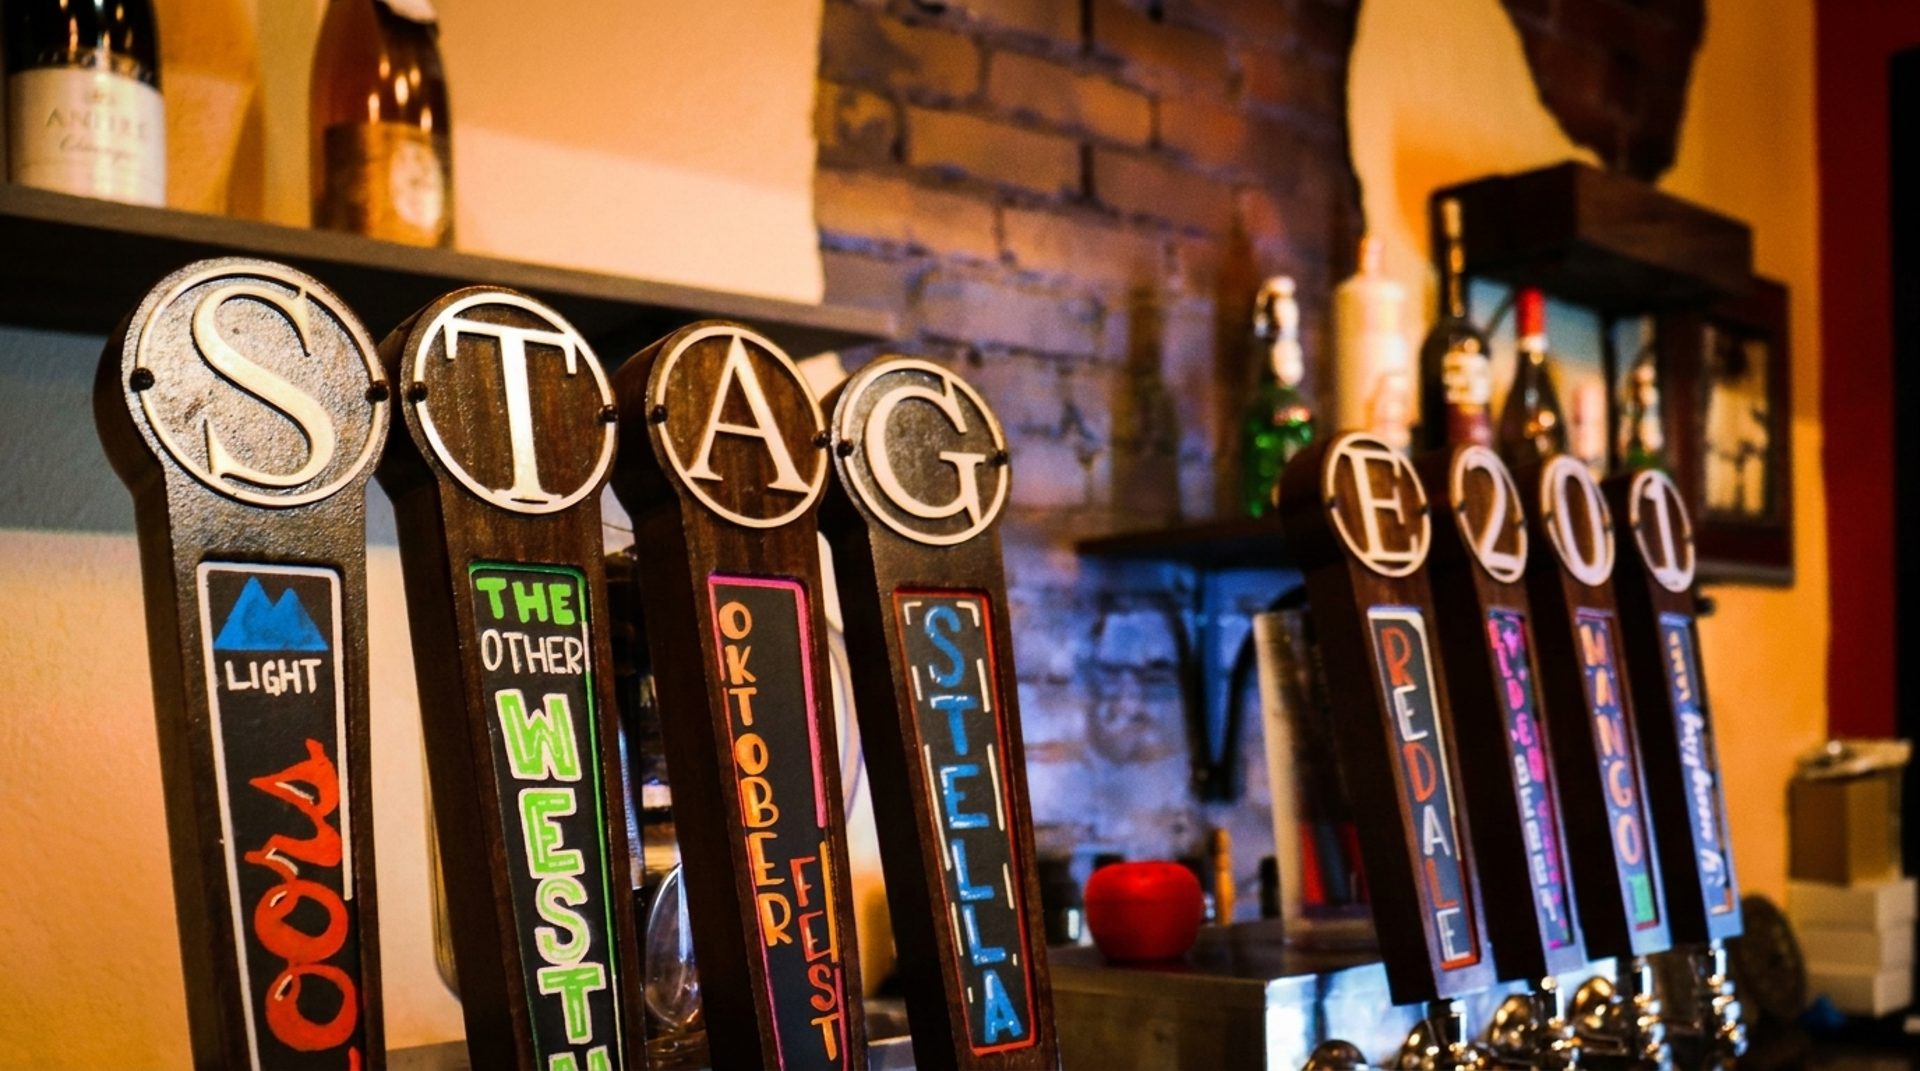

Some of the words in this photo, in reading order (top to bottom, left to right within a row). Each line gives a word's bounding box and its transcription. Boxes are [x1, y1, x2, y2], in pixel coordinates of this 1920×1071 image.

[225, 658, 321, 696] LIGHT
[476, 577, 576, 625] THE
[480, 629, 583, 676] OTHER
[719, 601, 792, 947] OKTOBER
[924, 605, 1023, 1044] STELLA
[1579, 623, 1642, 866] MANGO
[244, 738, 362, 1071] oors
[790, 855, 839, 1061] FEST
